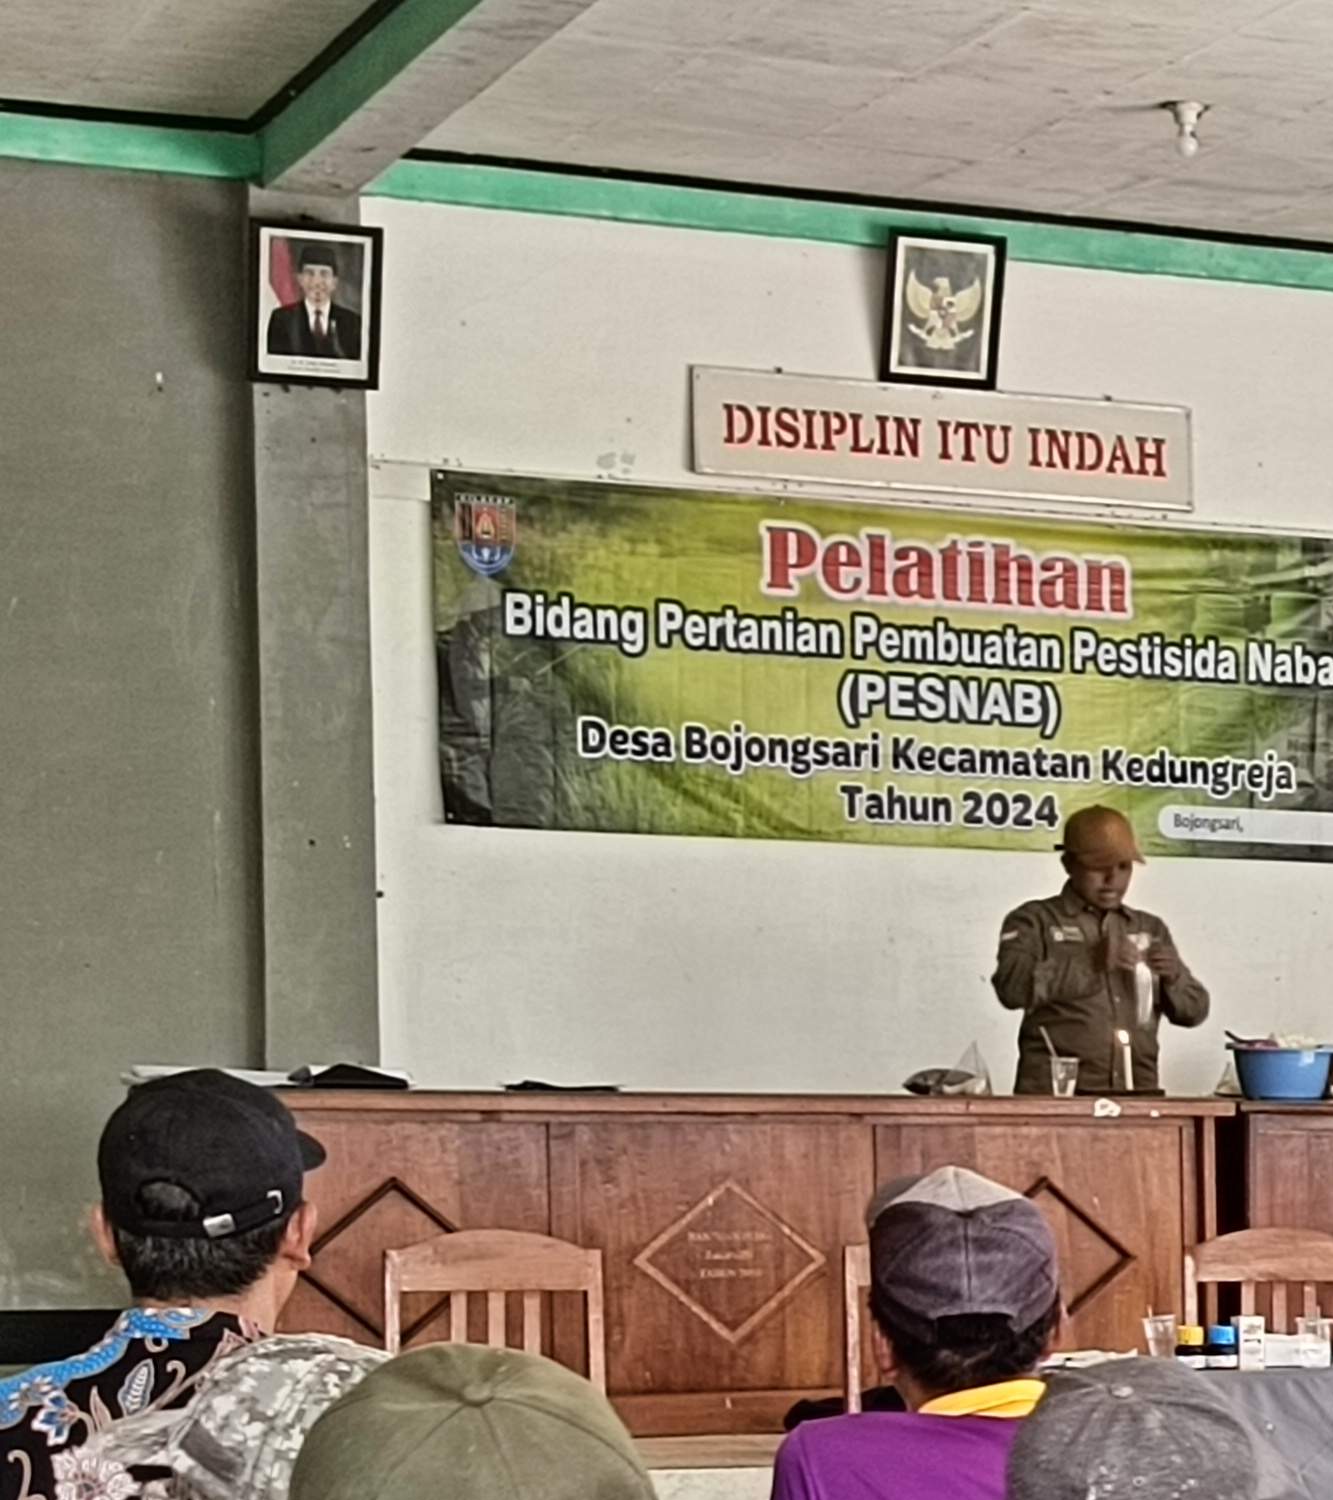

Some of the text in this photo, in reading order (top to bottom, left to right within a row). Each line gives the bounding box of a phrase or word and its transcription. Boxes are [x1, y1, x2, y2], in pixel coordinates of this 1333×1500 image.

[722, 403, 1167, 478] DISIPLIN ITU INDAH
[761, 523, 1130, 614] Pelatihan
[504, 592, 645, 654] Bidang
[658, 603, 841, 656] Pertanian
[854, 616, 1060, 670] Pembuatan
[1072, 631, 1238, 682] Pestisida
[840, 673, 1060, 735] (PESNAB)
[581, 720, 1294, 798] Desa Bojongsari Kecamatan Kedungreja
[840, 785, 1058, 829] Tahun 2024
[1173, 812, 1244, 833] Bojongsari,
